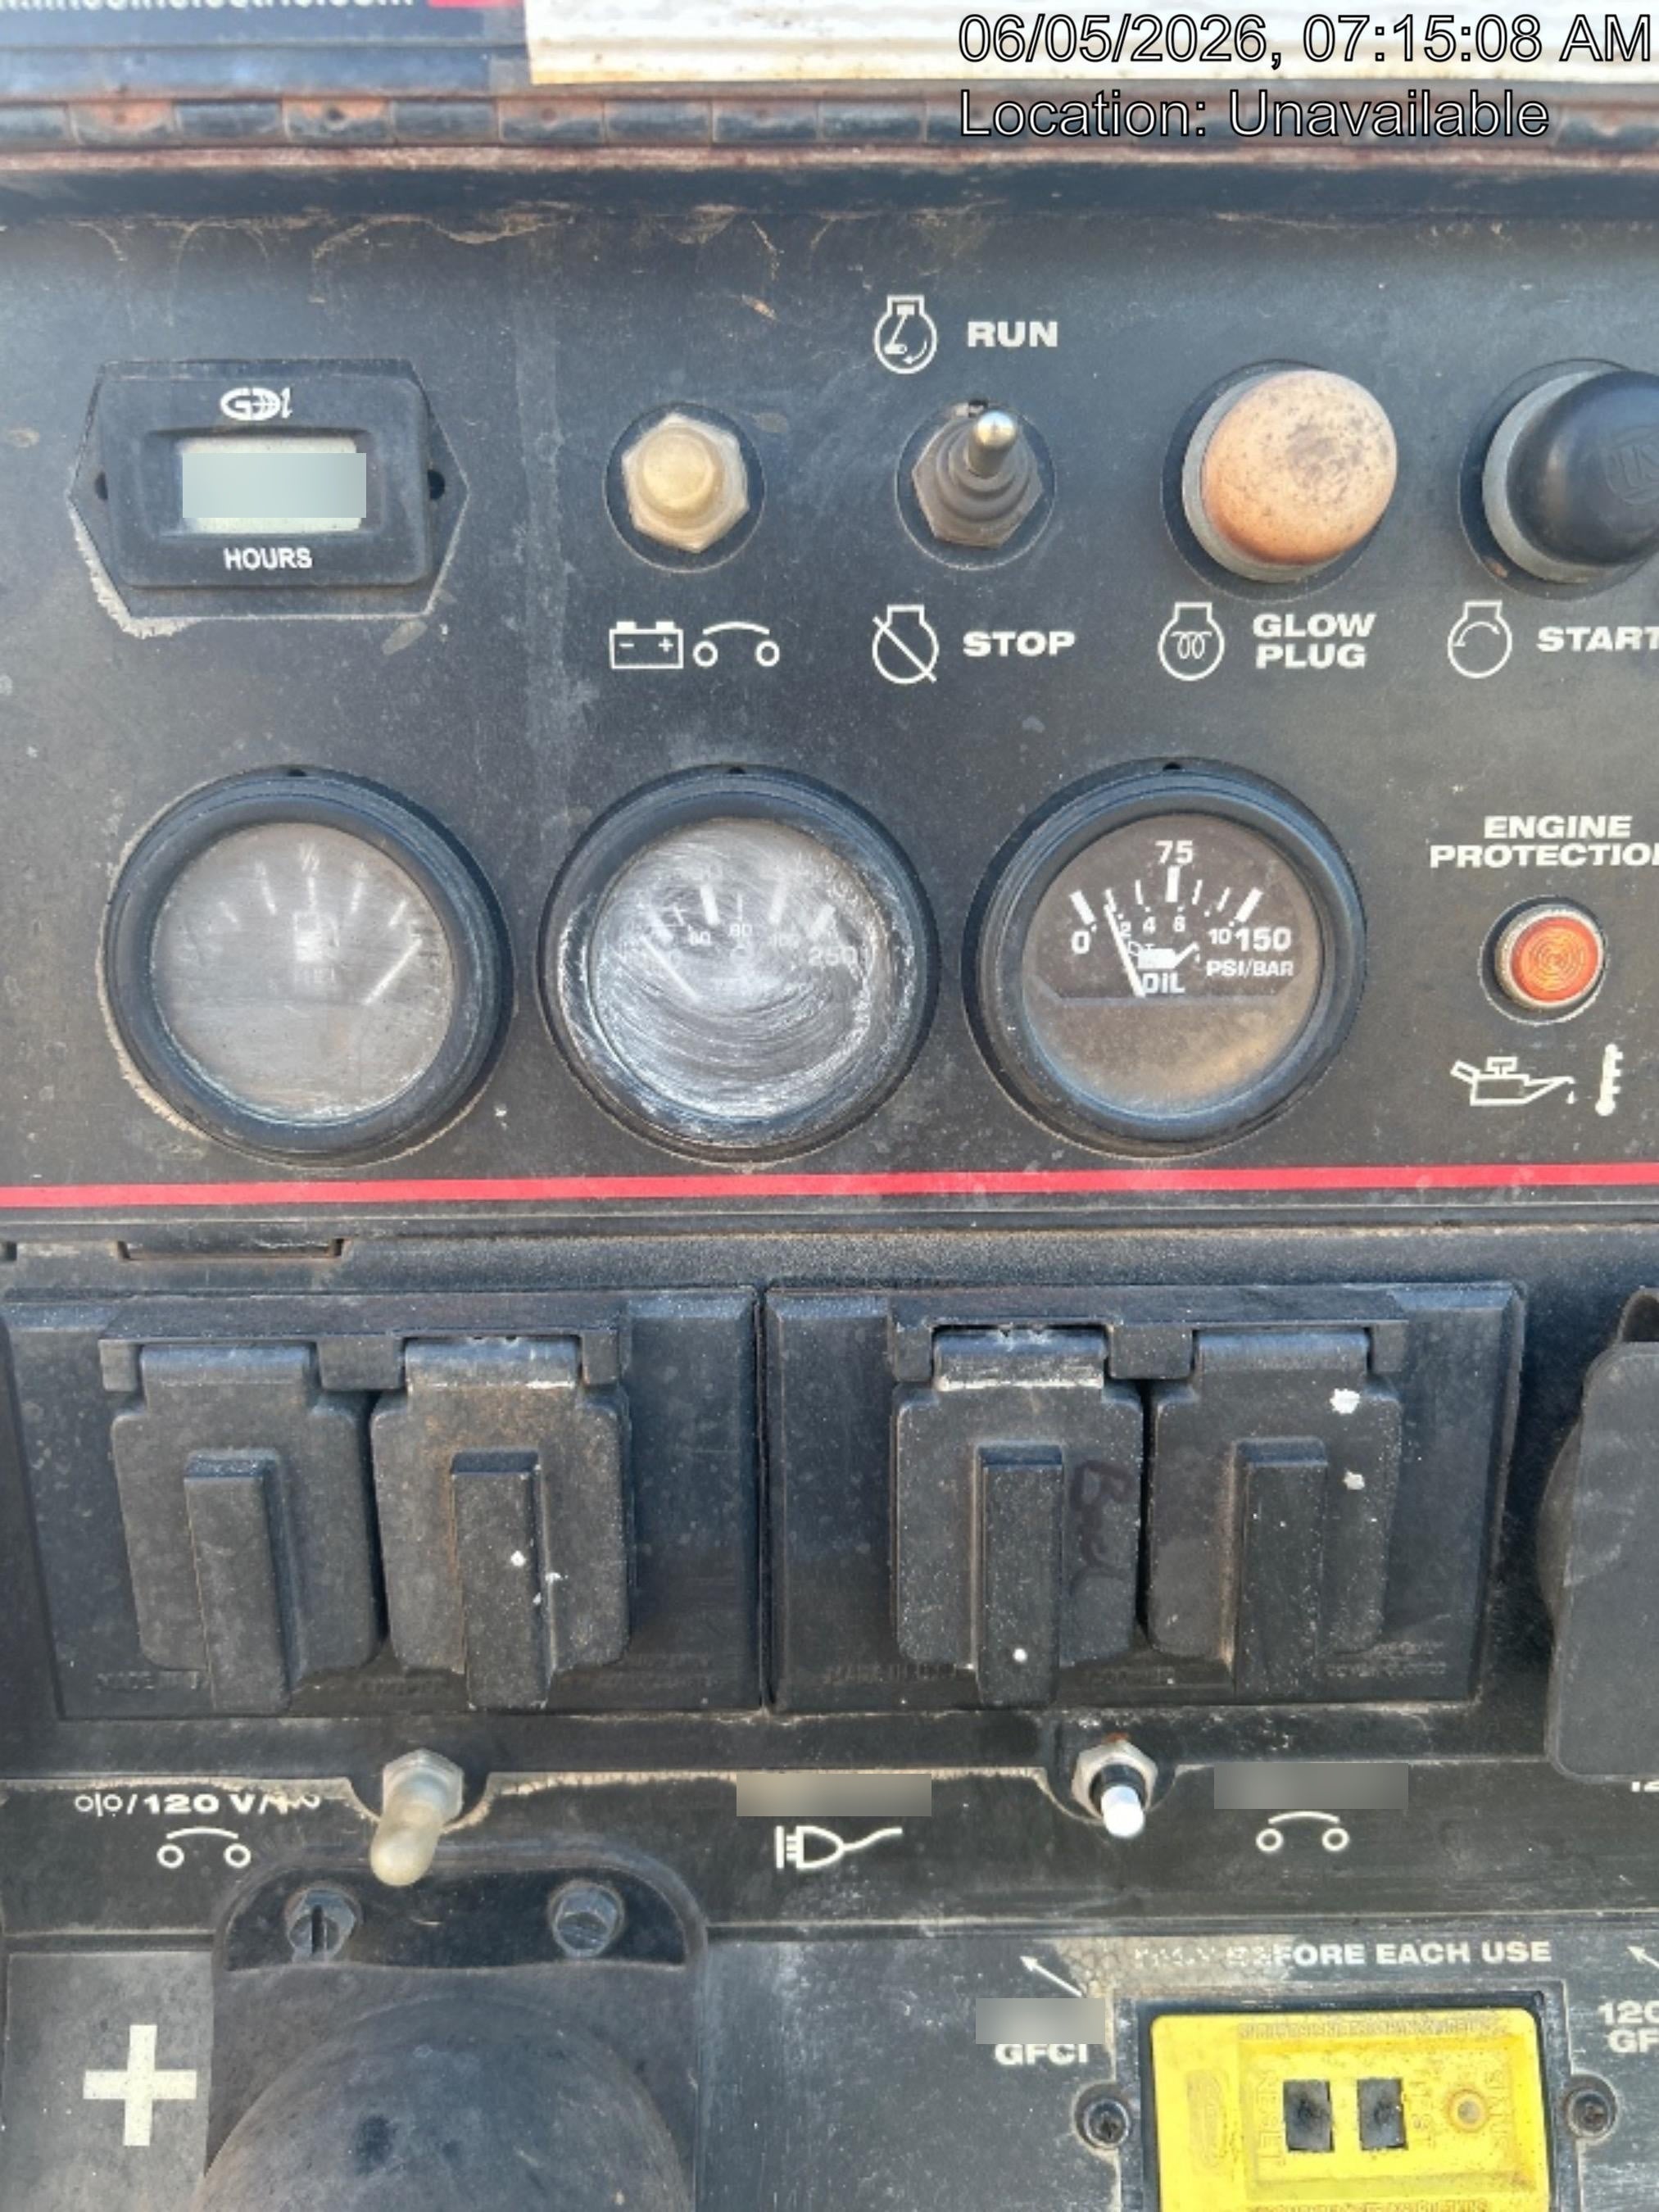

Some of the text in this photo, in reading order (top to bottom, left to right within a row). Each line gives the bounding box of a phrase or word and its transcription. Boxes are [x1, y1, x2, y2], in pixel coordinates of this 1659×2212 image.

[967, 321, 1058, 347] RUN
[223, 547, 313, 571] HOURS
[1253, 613, 1376, 639] GLOW
[963, 631, 1075, 657] STOP
[1256, 643, 1367, 670] PLUG
[1484, 814, 1633, 841] ENGINE
[1155, 840, 1194, 864] 75
[1430, 842, 1659, 869] PROTECTIO
[1143, 917, 1156, 934] 4
[1208, 928, 1231, 945] 10
[1072, 930, 1091, 955] 0
[1235, 927, 1292, 952] 150
[1206, 959, 1294, 977] PSI/BAR
[1376, 1942, 1471, 1965] EACH
[1481, 1941, 1552, 1964] USE
[995, 2043, 1088, 2065] GFCI
